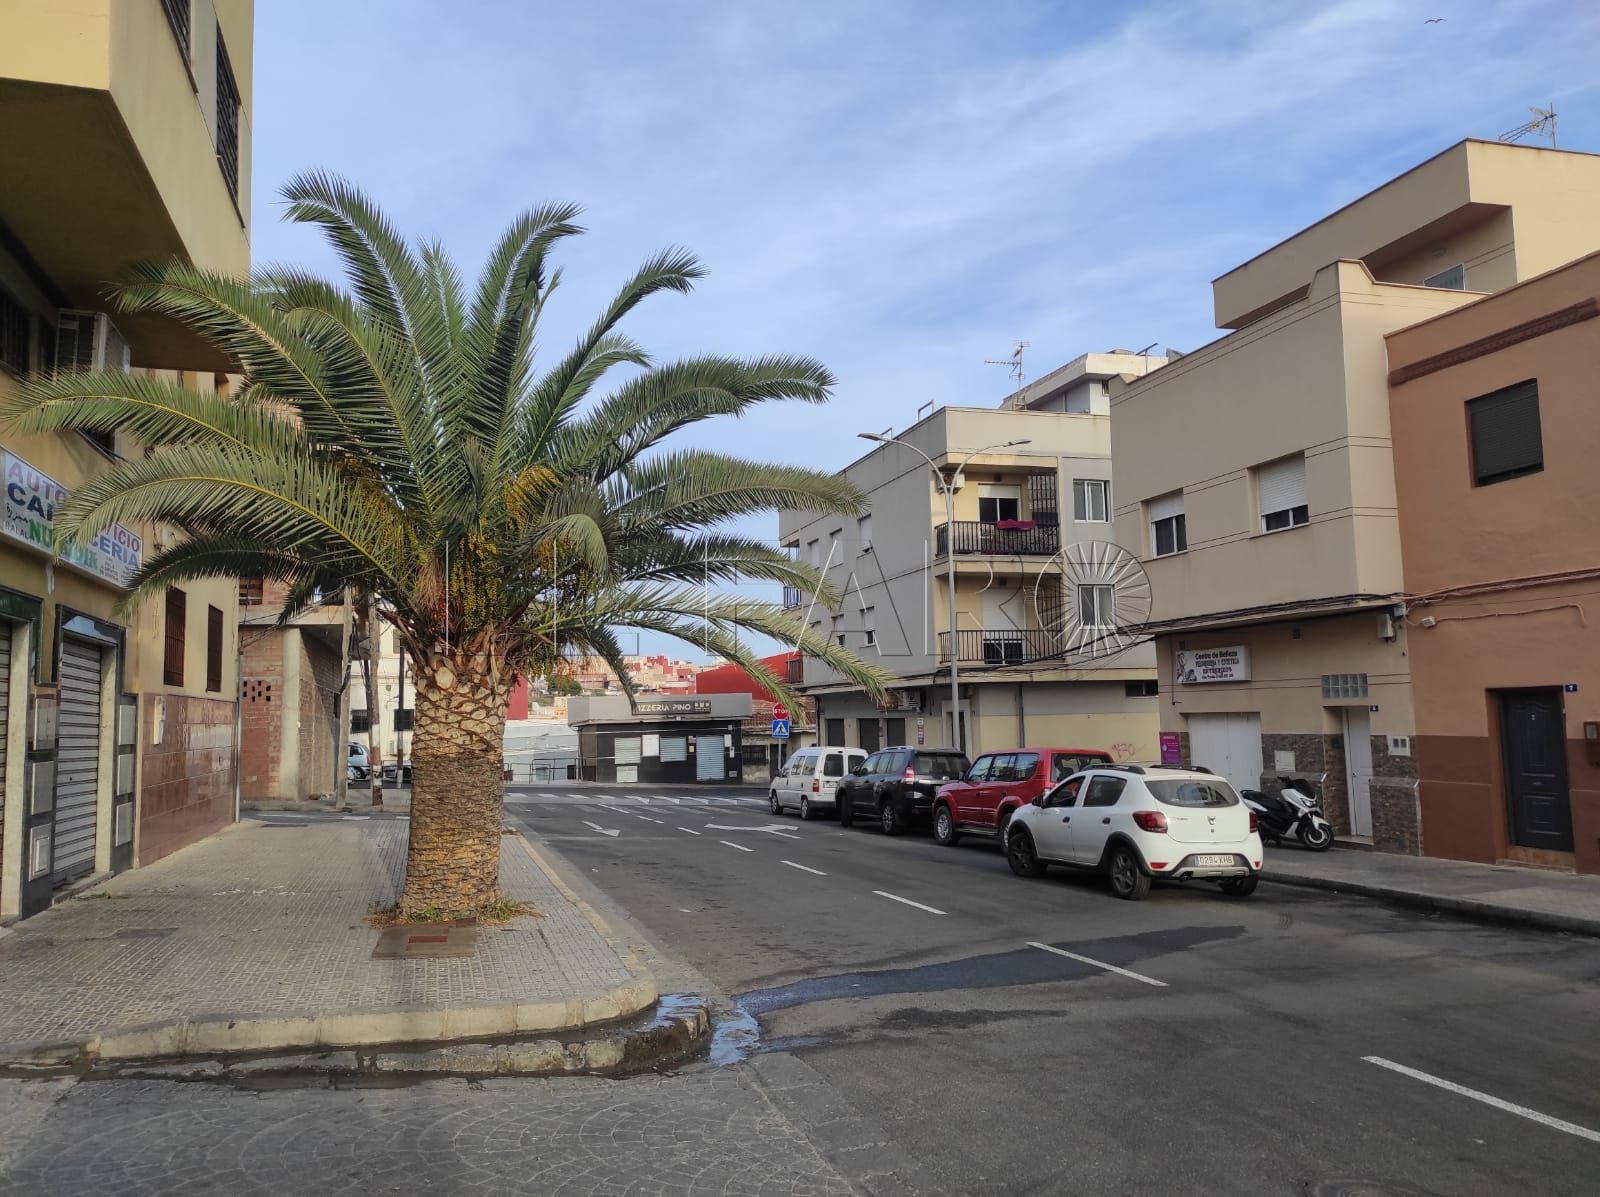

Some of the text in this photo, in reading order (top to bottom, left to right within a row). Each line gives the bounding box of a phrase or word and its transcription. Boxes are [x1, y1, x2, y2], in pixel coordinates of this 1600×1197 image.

[1219, 650, 1237, 658] Belleza
[637, 703, 670, 712] IZZERIA
[672, 703, 692, 711] PINO
